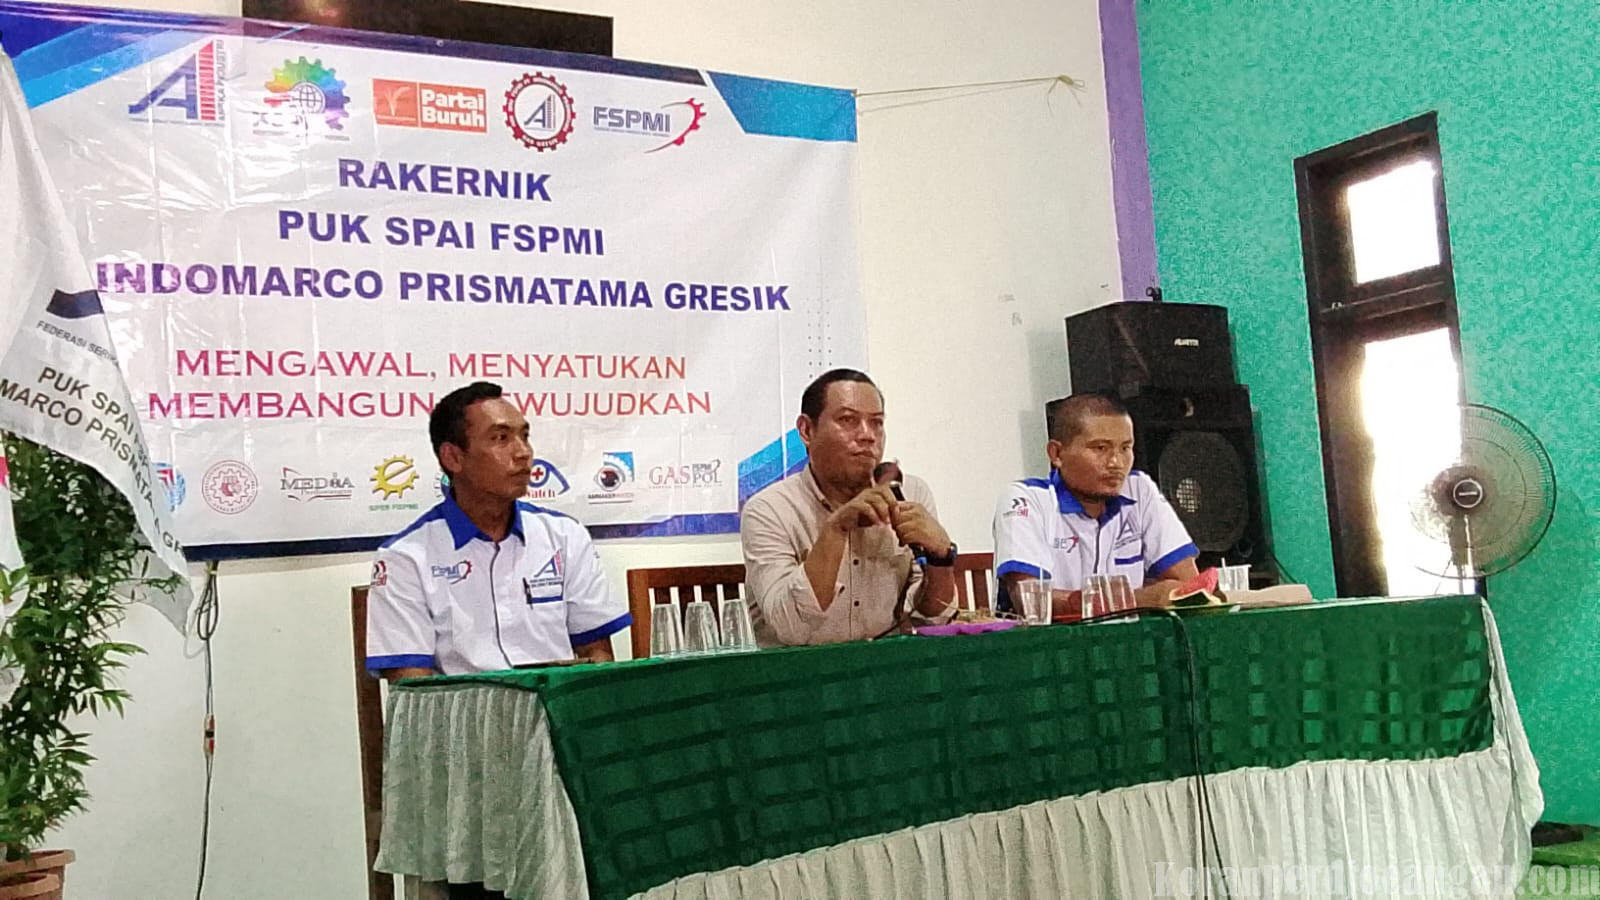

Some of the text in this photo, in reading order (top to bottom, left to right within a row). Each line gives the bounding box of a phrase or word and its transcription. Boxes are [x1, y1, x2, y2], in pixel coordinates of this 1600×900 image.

[421, 88, 484, 111] Partai
[422, 106, 485, 128] Buruh
[593, 105, 671, 133] FSPMI
[338, 159, 552, 202] RAKERNIK
[279, 210, 605, 255] PUK SPAI FSPMI
[97, 262, 791, 312] INDOMARCO PRISMATAMA GRESIK
[36, 320, 87, 348] FEDERASI
[176, 349, 687, 381] MENGAWAL, MENYATUKAN
[37, 366, 134, 436] PUK SPAI
[149, 391, 712, 420] MEMBANGUN WUJUDKAN
[648, 464, 691, 485] GAS
